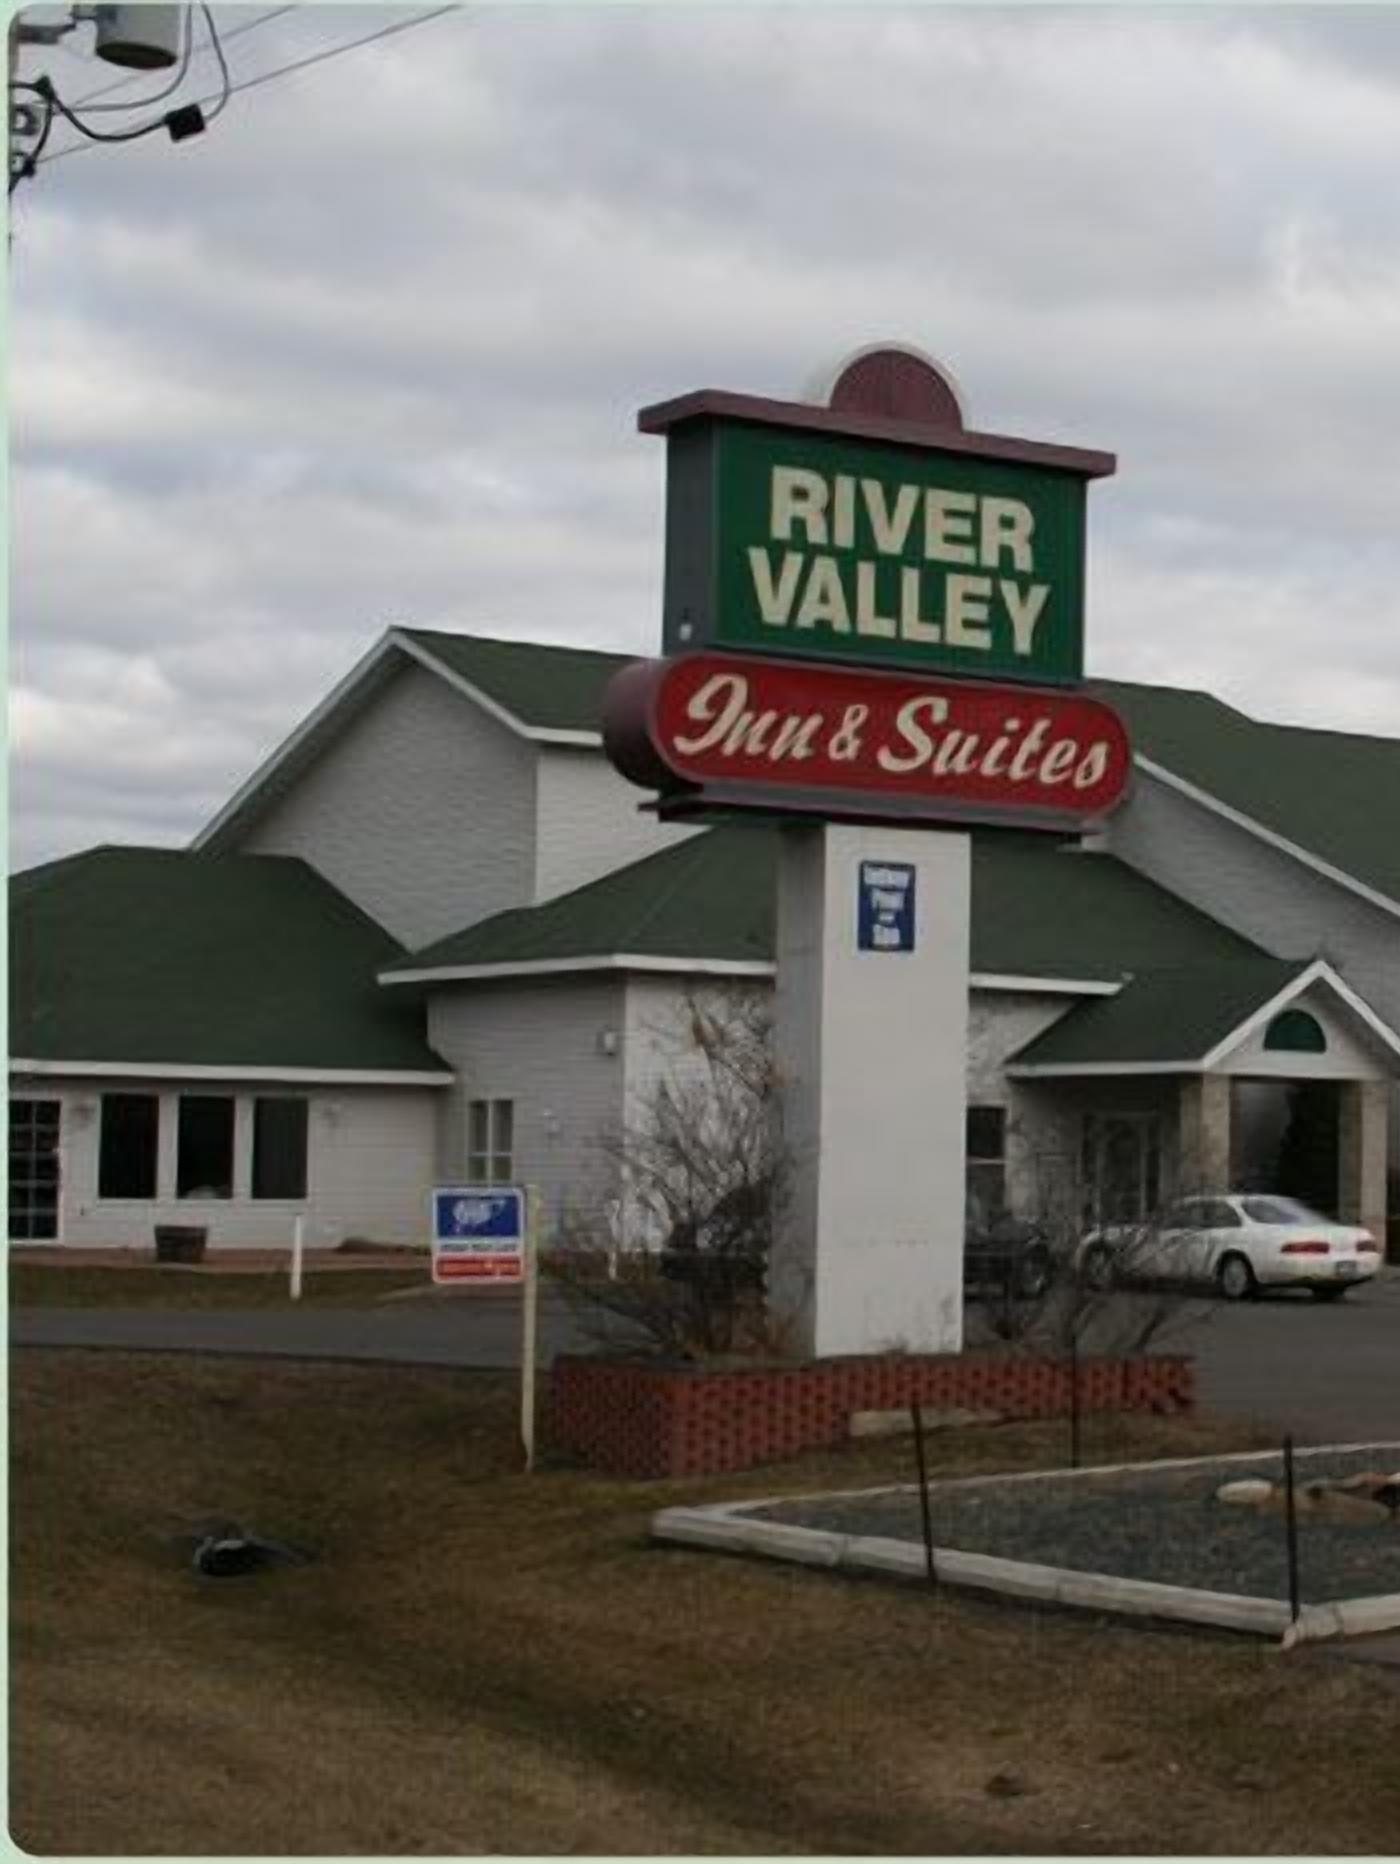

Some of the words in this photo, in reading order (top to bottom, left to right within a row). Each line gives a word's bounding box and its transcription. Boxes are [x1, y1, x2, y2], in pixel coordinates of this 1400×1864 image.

[770, 465, 1035, 572] RIVER
[748, 547, 1050, 656] VALLEY
[674, 674, 816, 759] Inn
[827, 704, 868, 760] &
[877, 696, 1108, 789] Suites
